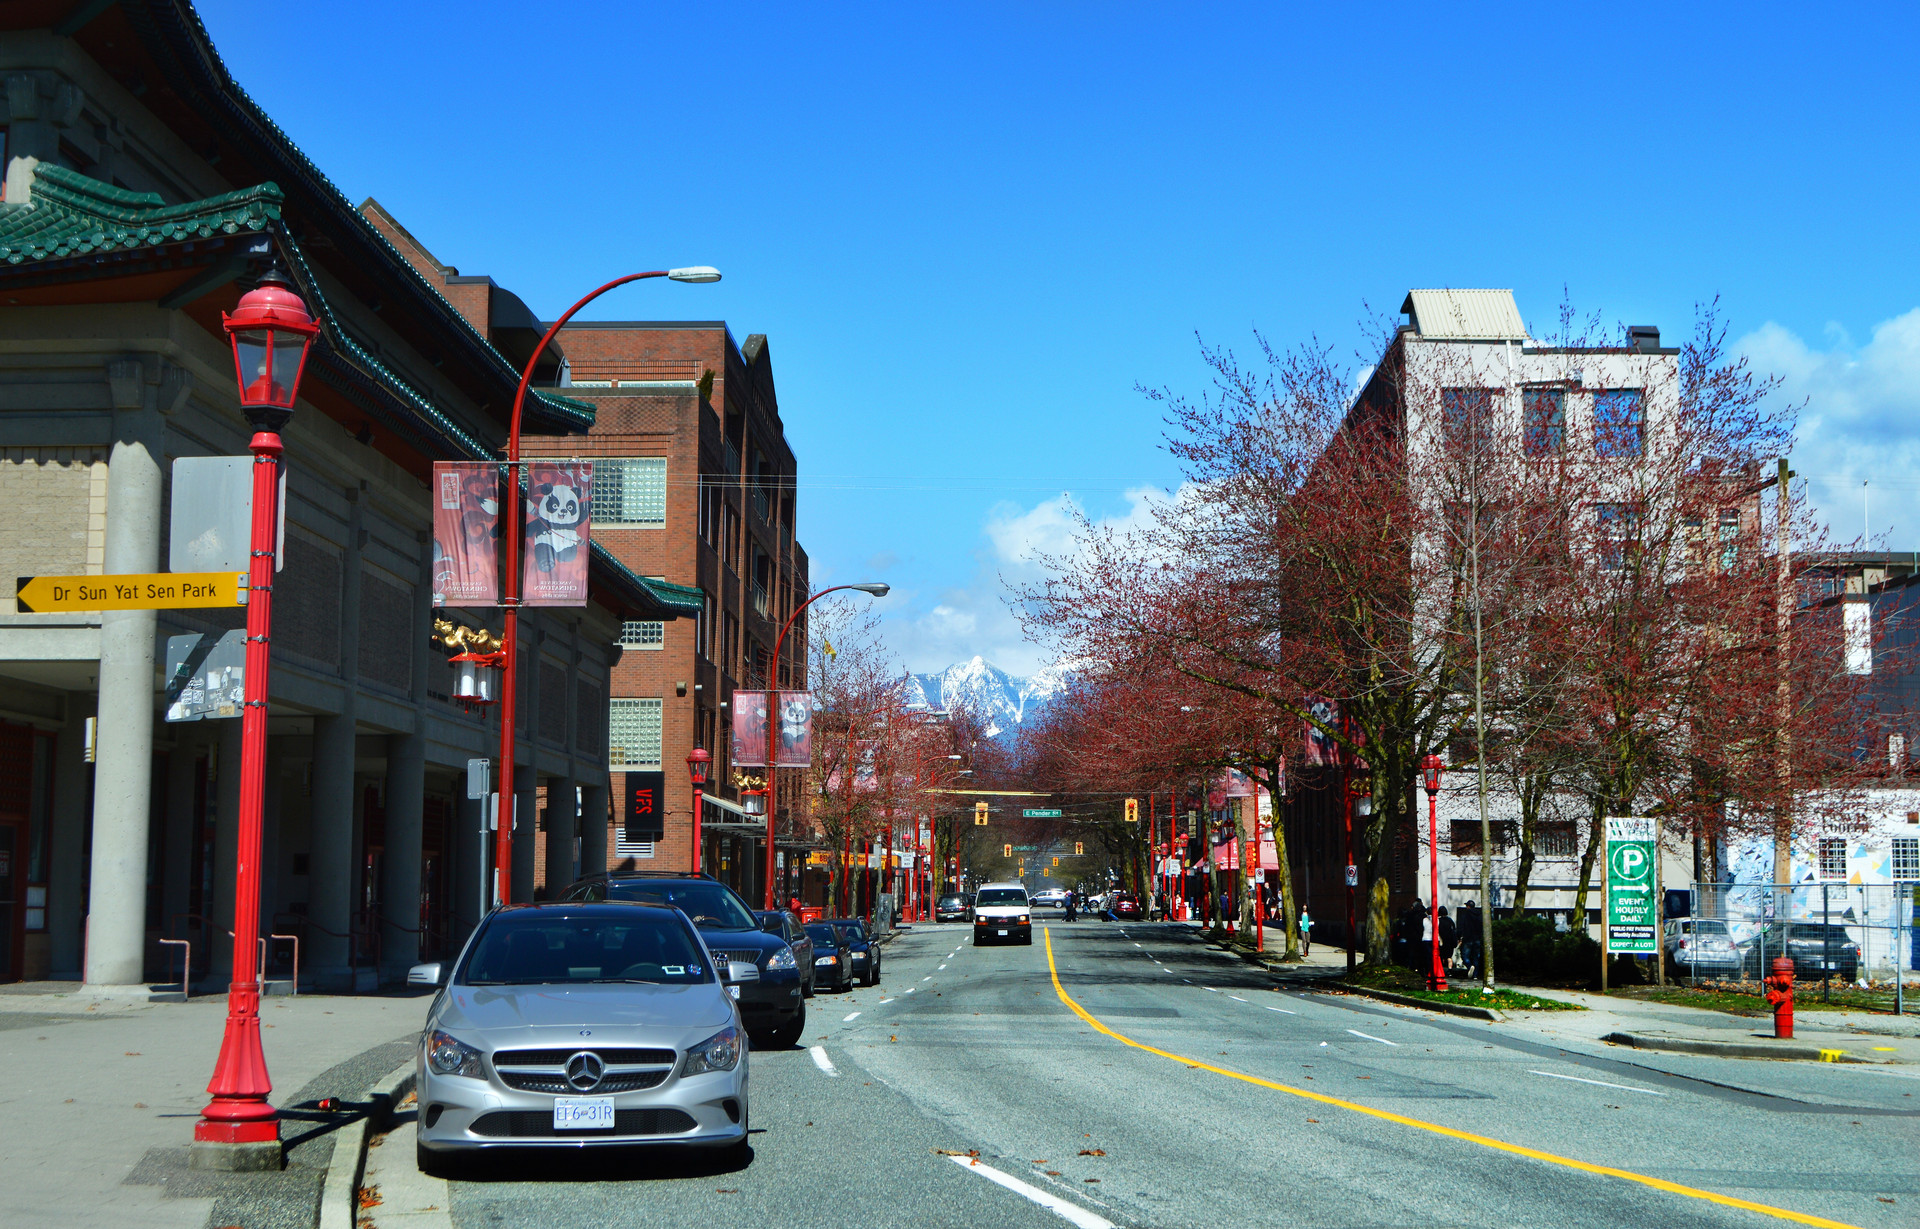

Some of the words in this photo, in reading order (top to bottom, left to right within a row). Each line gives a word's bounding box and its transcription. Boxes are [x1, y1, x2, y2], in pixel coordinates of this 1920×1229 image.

[53, 586, 70, 601] Dr
[79, 585, 107, 600] Sun
[114, 584, 139, 599] Yat
[147, 583, 175, 598] Sen
[183, 583, 216, 598] Park
[636, 789, 652, 814] VFS
[1623, 821, 1649, 829] West
[1623, 849, 1643, 874] P
[1615, 906, 1649, 914] HOURLY
